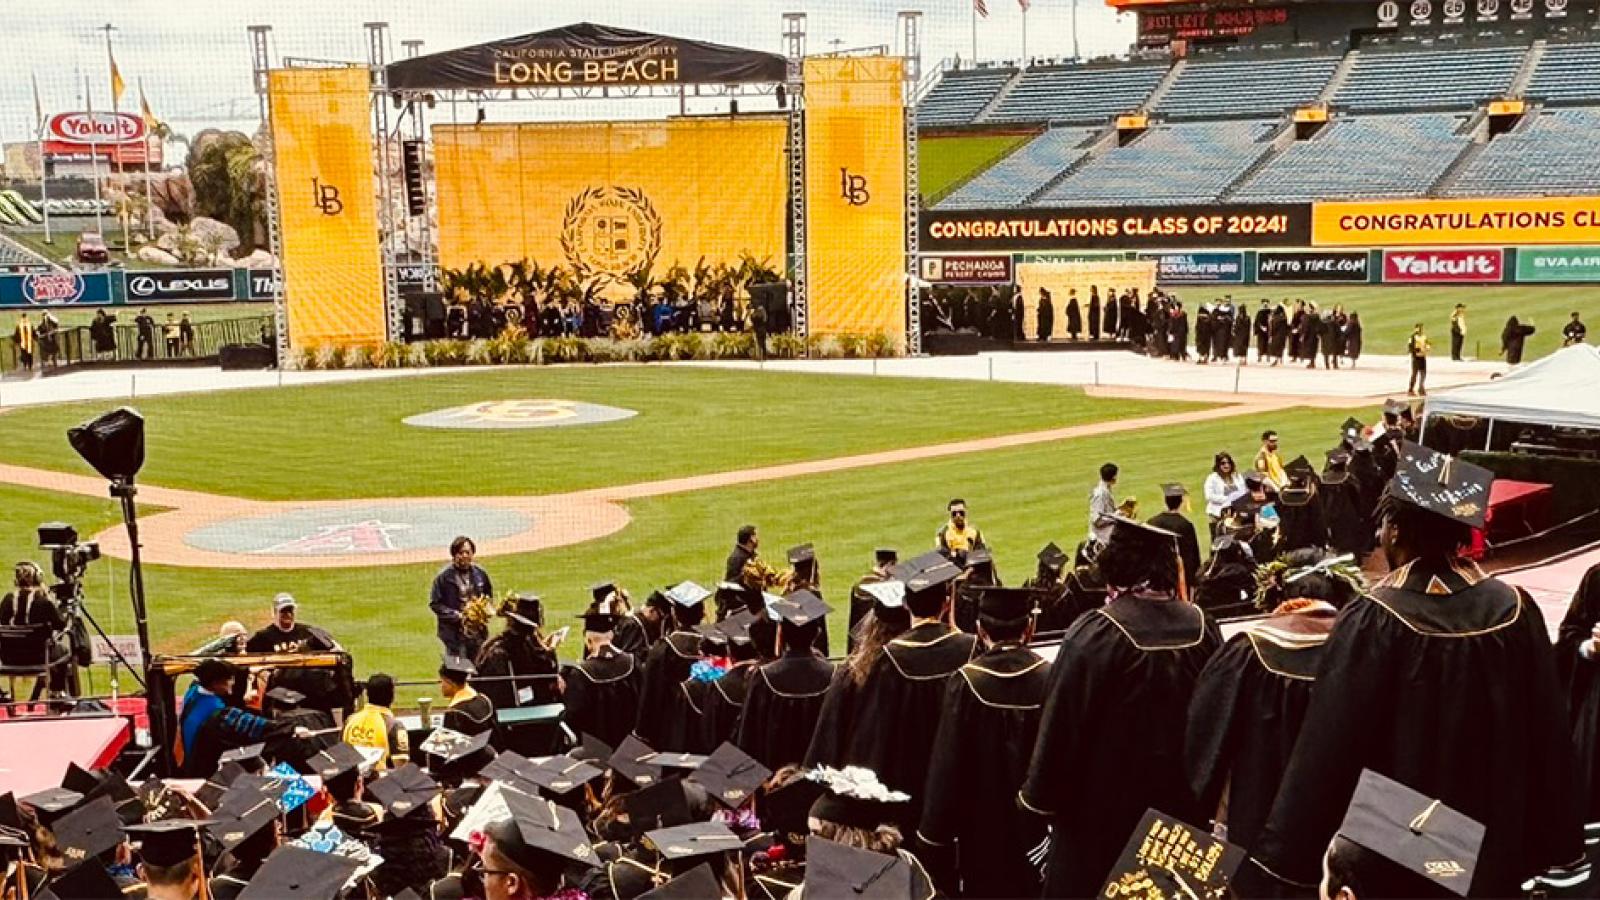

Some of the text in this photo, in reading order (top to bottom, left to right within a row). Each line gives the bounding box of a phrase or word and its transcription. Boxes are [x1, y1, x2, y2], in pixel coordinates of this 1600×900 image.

[494, 48, 566, 59] CALIFORNIA
[494, 58, 679, 84] LONG BEACH
[67, 119, 134, 136] Yakult
[929, 215, 1288, 239] CONGRATULATIONS CLASS OF 2024!
[1339, 211, 1566, 231] CONGRATULATIONS
[945, 260, 1005, 271] PECHANGA
[1260, 257, 1366, 272] NITTO TIRE.COM
[1391, 255, 1494, 275] Yakult
[157, 278, 229, 291] LEXUS
